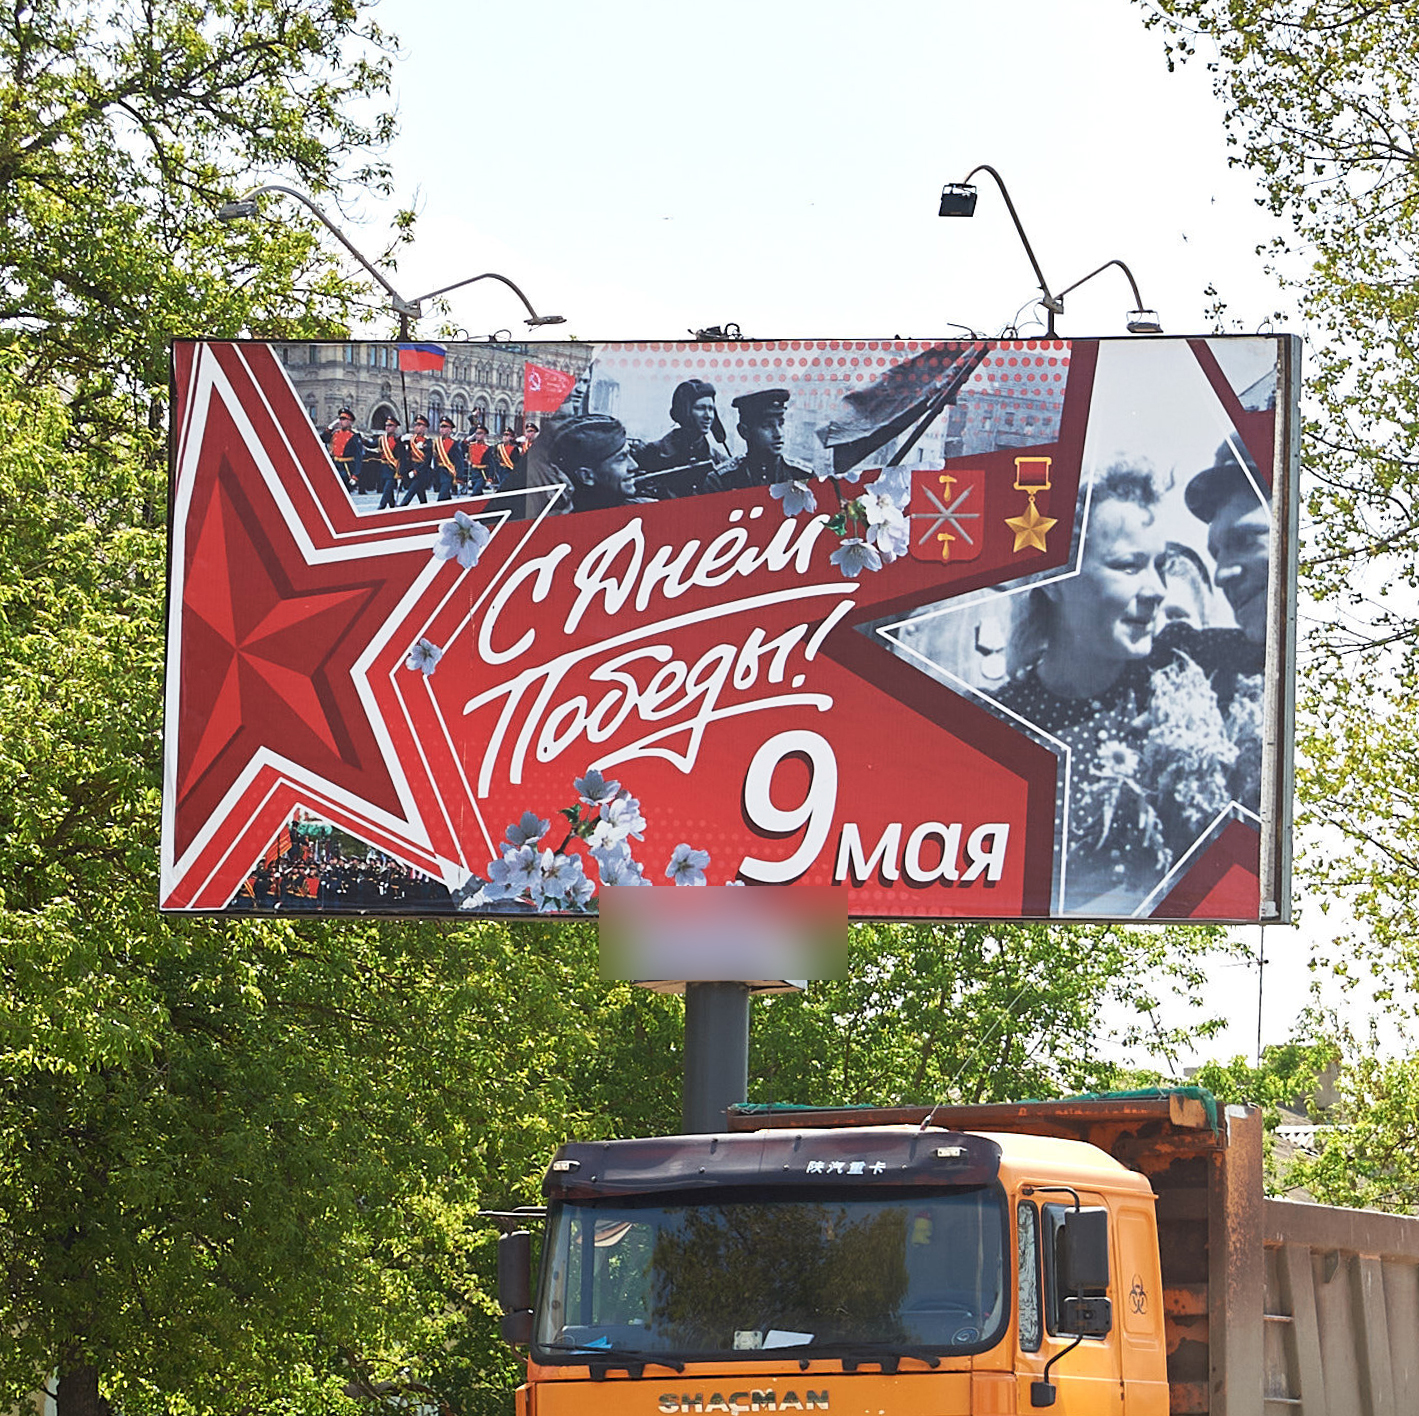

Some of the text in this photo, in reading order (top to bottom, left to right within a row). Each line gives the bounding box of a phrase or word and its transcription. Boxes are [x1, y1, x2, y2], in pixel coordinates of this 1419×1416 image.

[478, 507, 830, 664] С Днём
[463, 585, 858, 799] Победы!
[738, 730, 1010, 883] 9 мая
[805, 1160, 887, 1175] 陕汽重卡
[658, 1389, 829, 1415] SHACMAN
